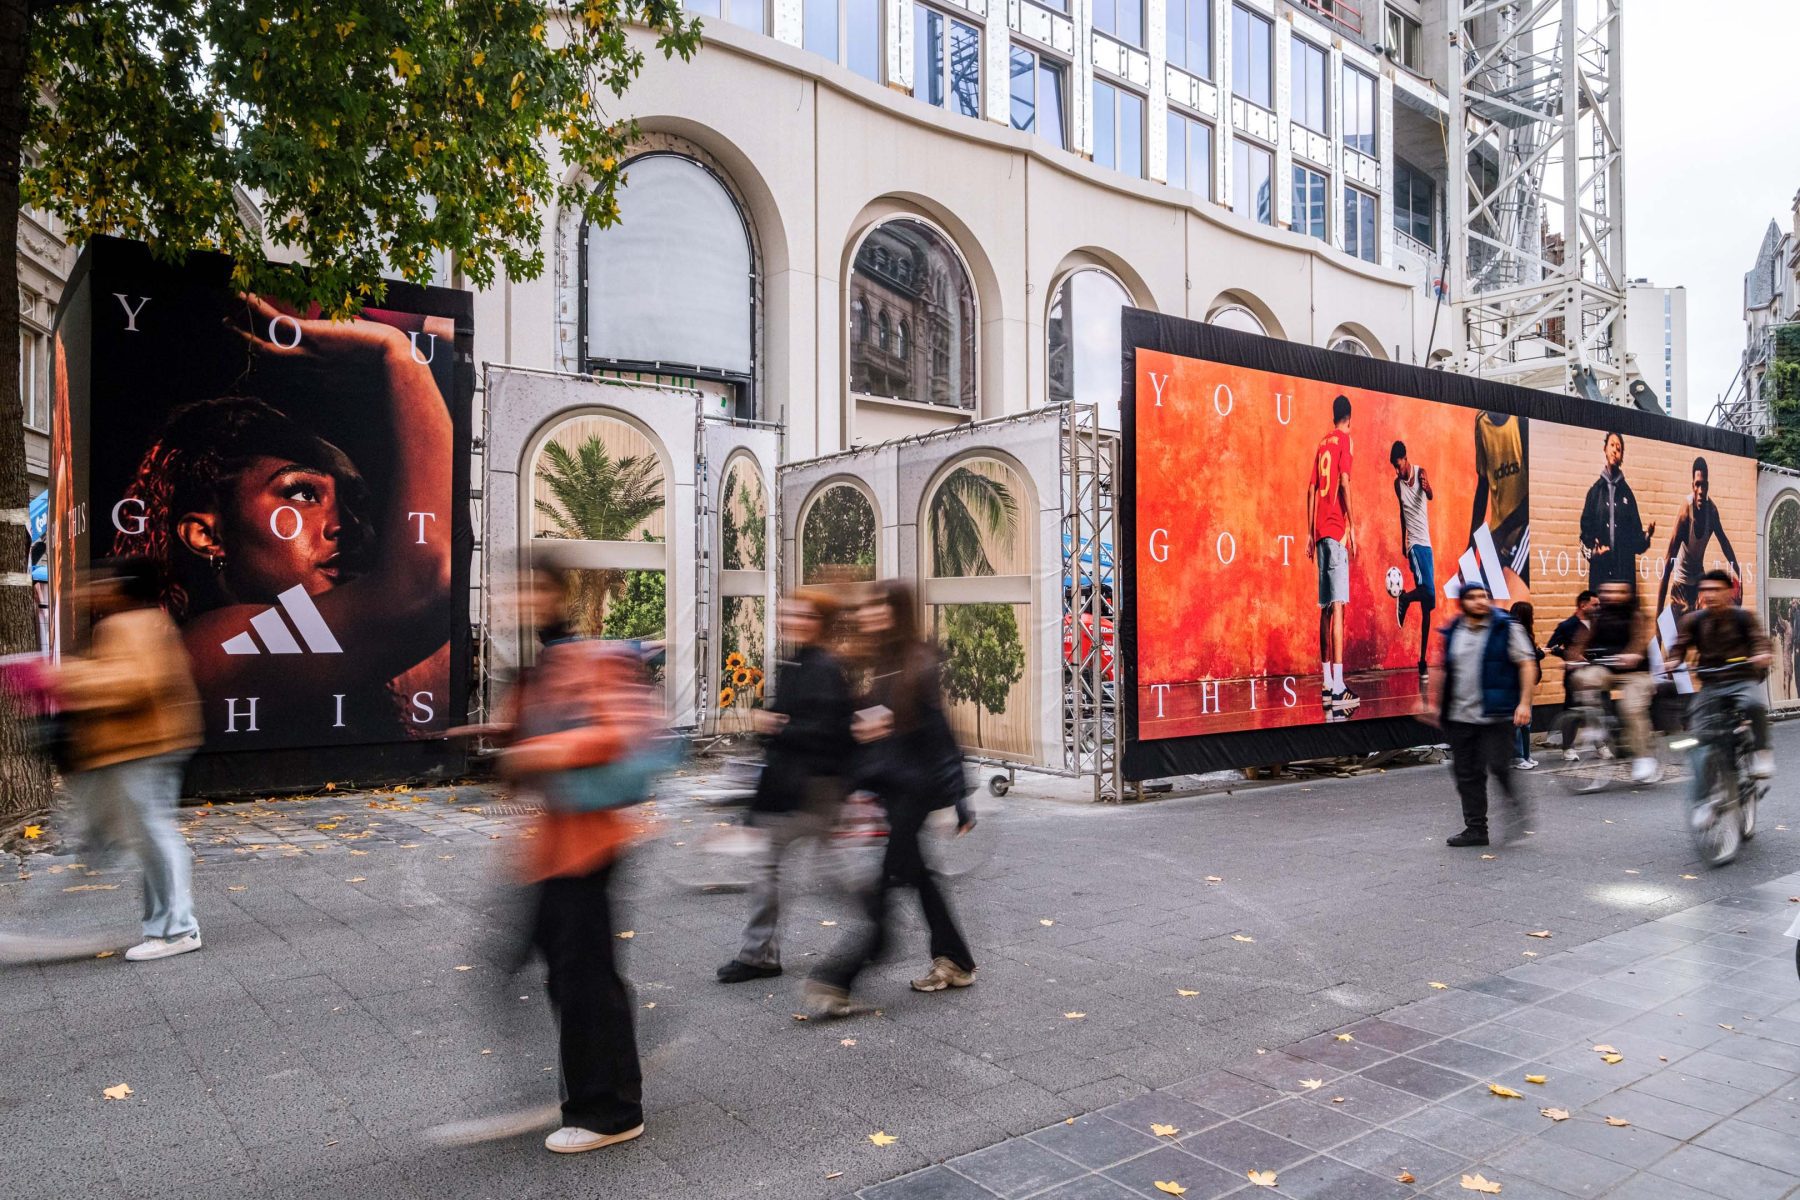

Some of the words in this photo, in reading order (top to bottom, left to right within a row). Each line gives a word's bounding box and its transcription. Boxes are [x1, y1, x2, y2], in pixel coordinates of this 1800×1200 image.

[113, 293, 438, 365] YOU
[1149, 372, 1293, 425] YOU
[112, 498, 436, 545] GOT
[1150, 528, 1295, 566] GOT
[1538, 549, 1588, 577] YOU
[1640, 556, 1679, 581] GOT
[224, 690, 435, 733] HIS
[1150, 676, 1297, 718] THIS
